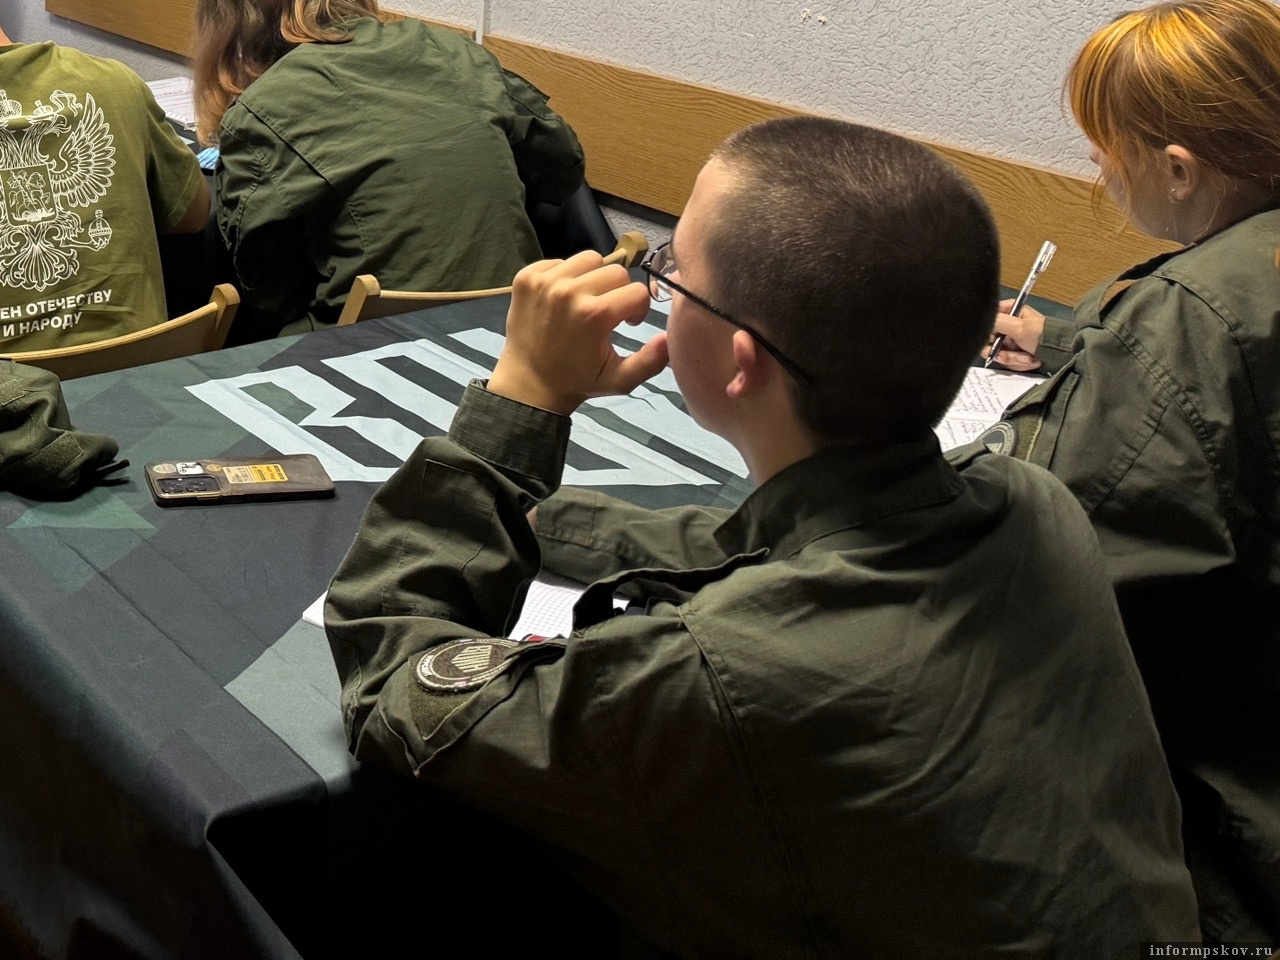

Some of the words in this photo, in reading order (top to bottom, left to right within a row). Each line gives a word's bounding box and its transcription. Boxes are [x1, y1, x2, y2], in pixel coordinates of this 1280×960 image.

[25, 289, 112, 315] ОТЕЧЕСТВУ
[3, 324, 15, 337] И
[20, 311, 83, 335] НАРОДУ
